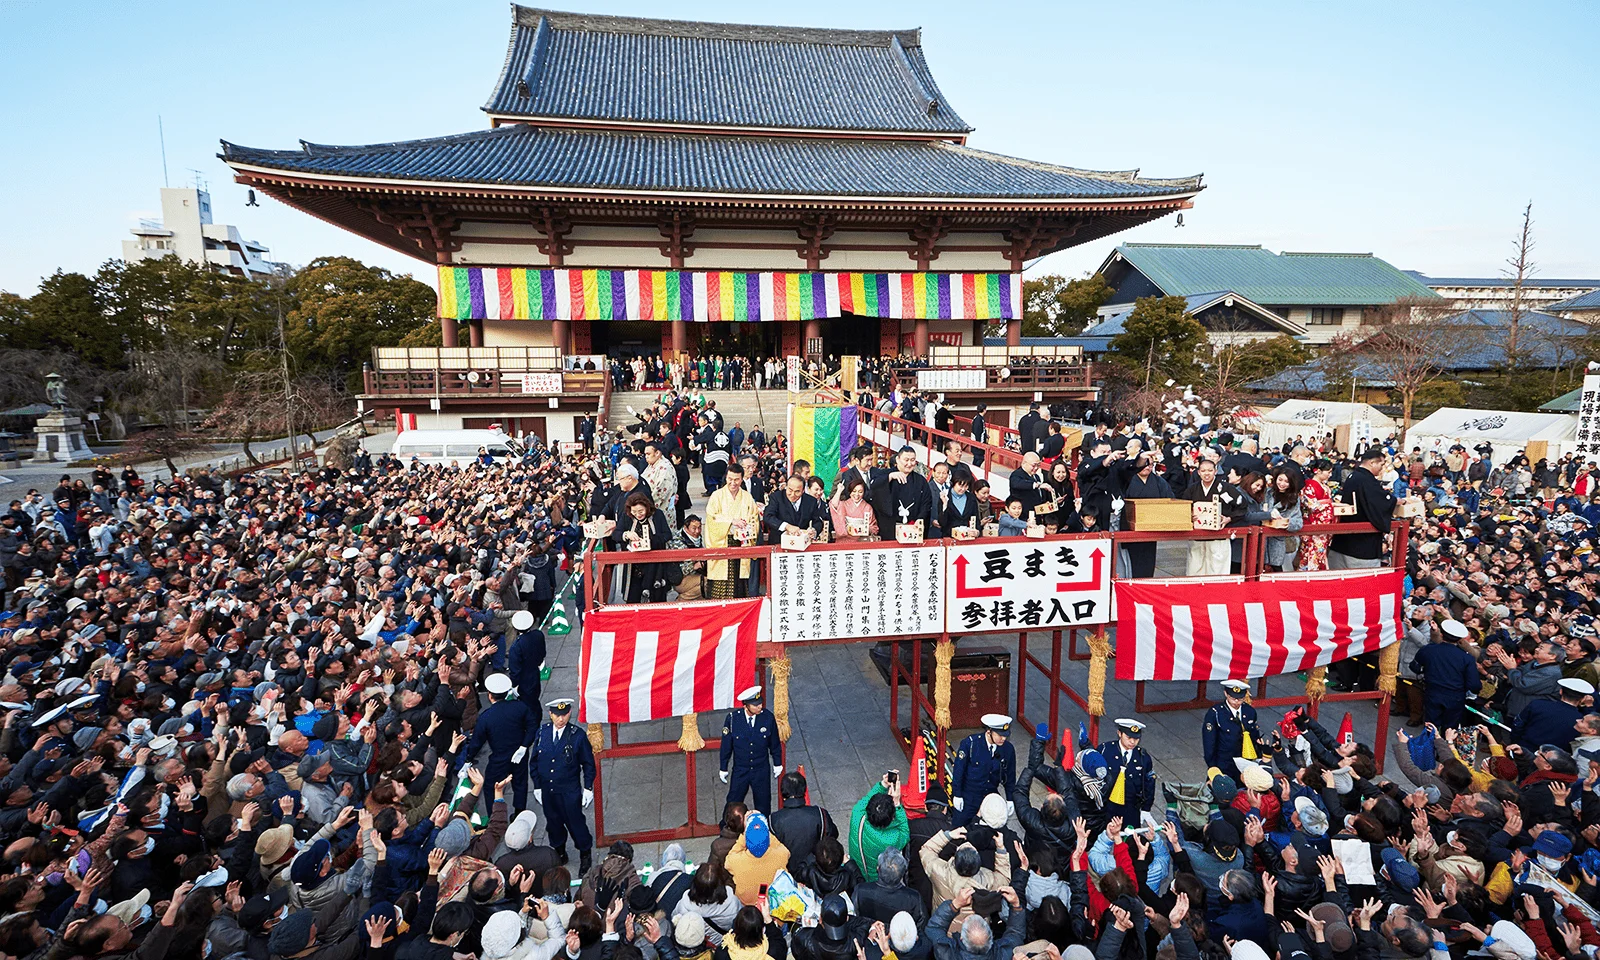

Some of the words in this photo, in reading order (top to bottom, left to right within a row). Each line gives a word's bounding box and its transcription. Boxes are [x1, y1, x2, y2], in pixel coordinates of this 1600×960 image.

[979, 546, 1080, 583] 豆まき
[961, 598, 1097, 629] 参拝者入口
